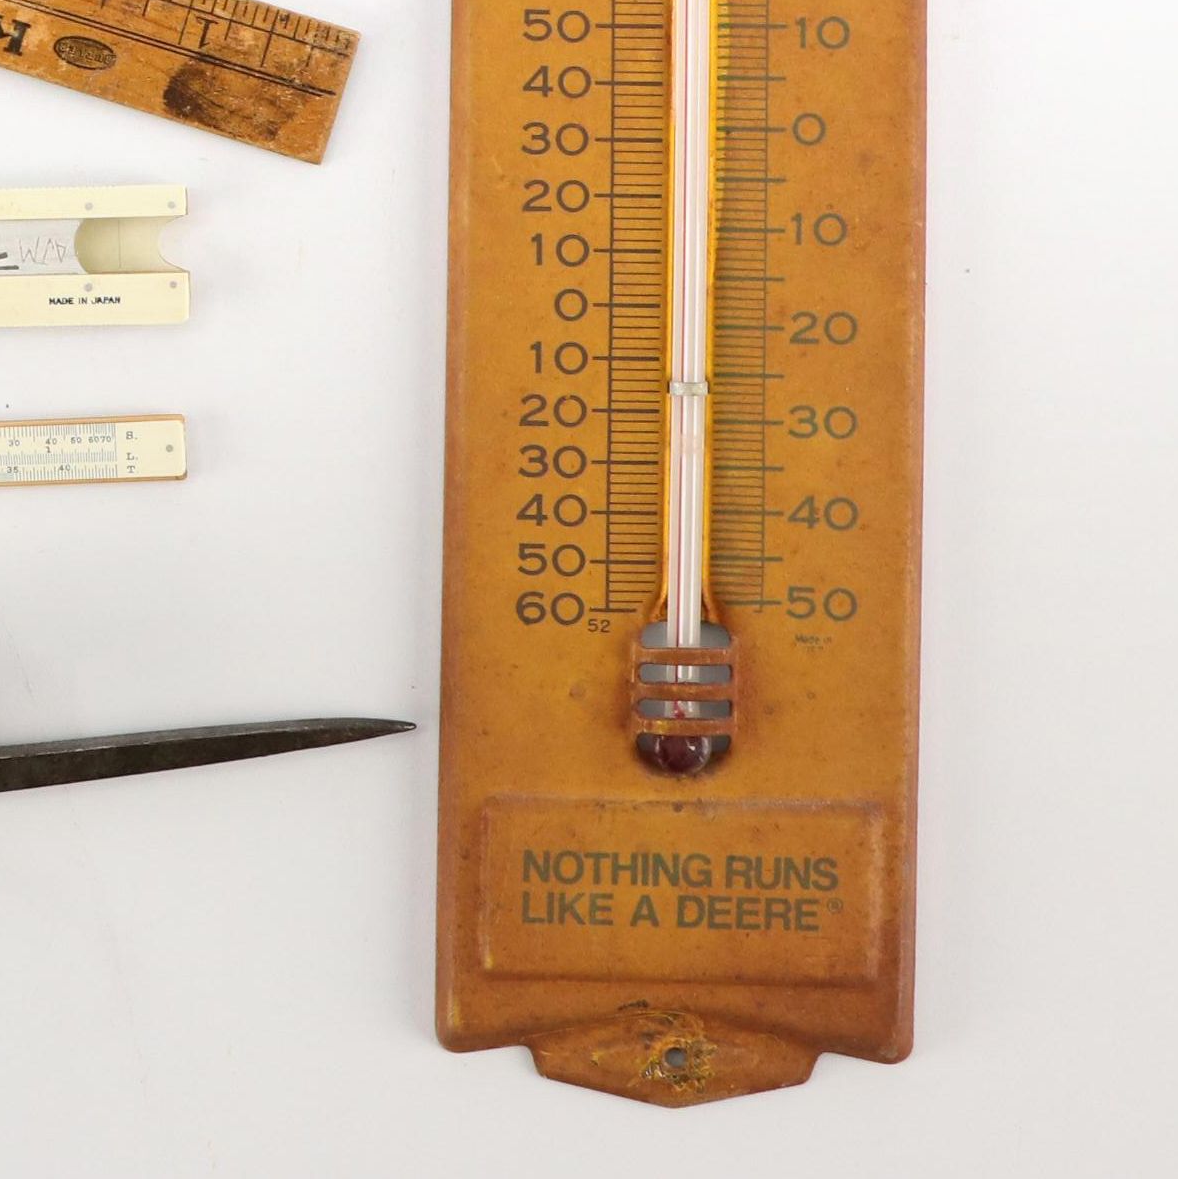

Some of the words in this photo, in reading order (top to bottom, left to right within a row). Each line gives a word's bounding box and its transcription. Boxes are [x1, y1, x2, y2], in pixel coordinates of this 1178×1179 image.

[196, 16, 220, 49] 1
[522, 10, 591, 43] 50
[794, 16, 850, 49] 10
[522, 65, 592, 99] 40
[521, 122, 590, 156] 30
[792, 113, 827, 146] 0
[521, 179, 590, 213] 20
[792, 213, 848, 246] 10
[531, 234, 590, 267] 10
[49, 297, 74, 305] MADE
[78, 297, 88, 305] IN
[92, 296, 121, 305] JAPAN
[554, 288, 589, 321] 0
[789, 311, 858, 345] 20
[530, 342, 589, 375] 10
[519, 394, 588, 428] 20
[787, 405, 857, 439] 30
[518, 445, 588, 479] 30
[516, 494, 588, 526] 40
[786, 496, 859, 530] 40
[517, 543, 586, 577] 50
[515, 592, 585, 625] 60
[785, 587, 858, 622] 50
[587, 619, 611, 633] 52
[522, 850, 712, 887] NOTHING
[725, 855, 839, 892] RUNS
[522, 891, 615, 926] LIKE
[630, 895, 660, 927] A
